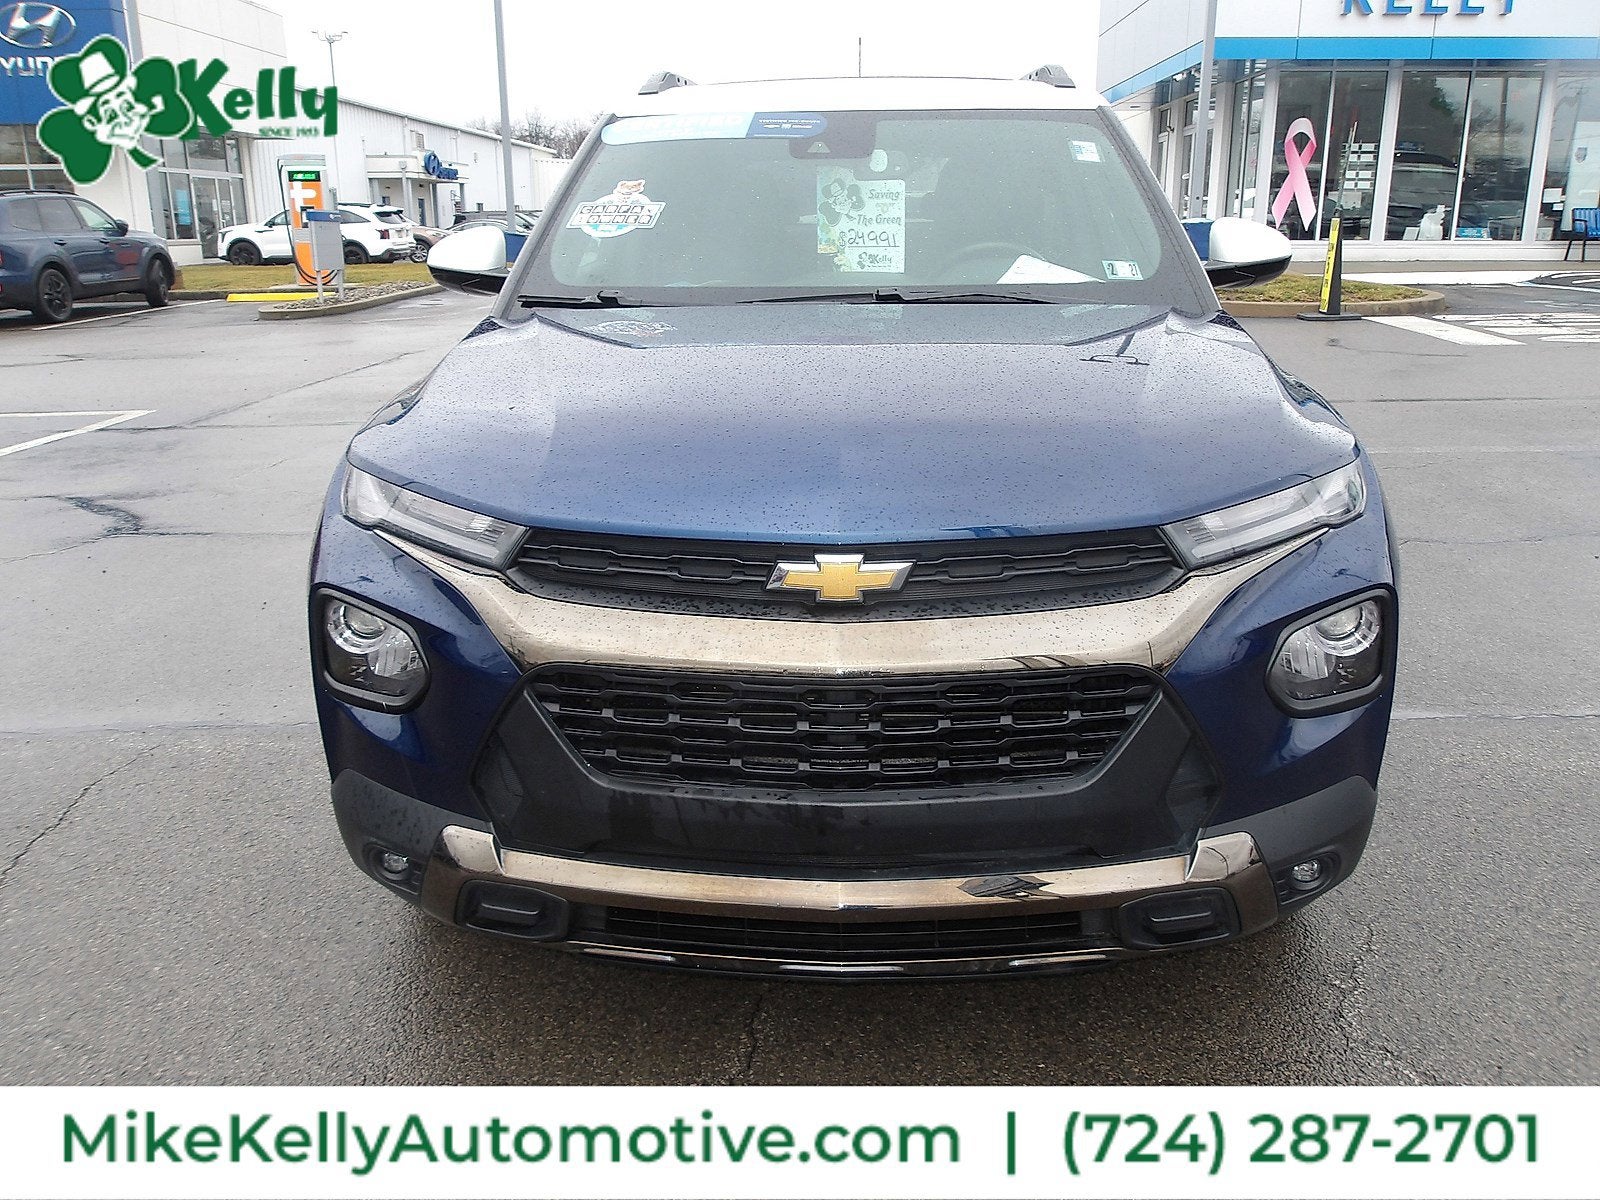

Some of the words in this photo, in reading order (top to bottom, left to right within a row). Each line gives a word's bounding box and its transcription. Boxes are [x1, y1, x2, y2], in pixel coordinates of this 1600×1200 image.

[868, 188, 899, 201] Saving
[857, 214, 875, 226] The
[876, 213, 902, 226] Green
